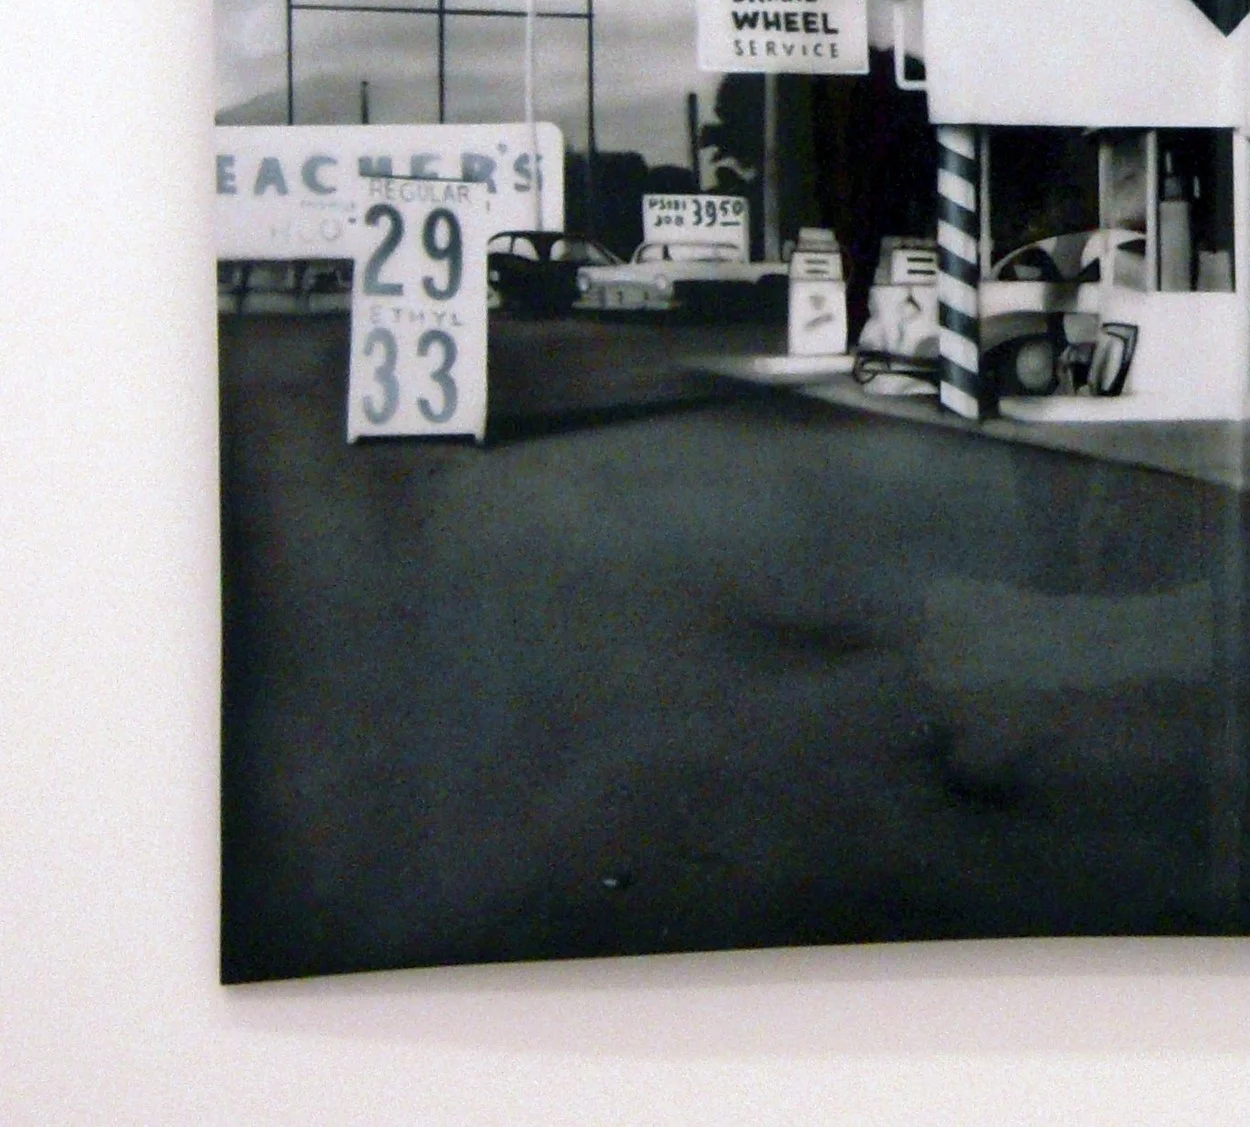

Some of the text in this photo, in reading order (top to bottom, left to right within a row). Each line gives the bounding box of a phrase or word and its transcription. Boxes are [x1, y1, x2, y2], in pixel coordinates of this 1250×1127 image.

[731, 11, 839, 35] WHEEL
[734, 40, 839, 59] SERVICE
[368, 178, 472, 204] REGULAR
[363, 203, 463, 301] 29
[369, 304, 464, 327] ETHYL
[363, 328, 459, 425] 33
